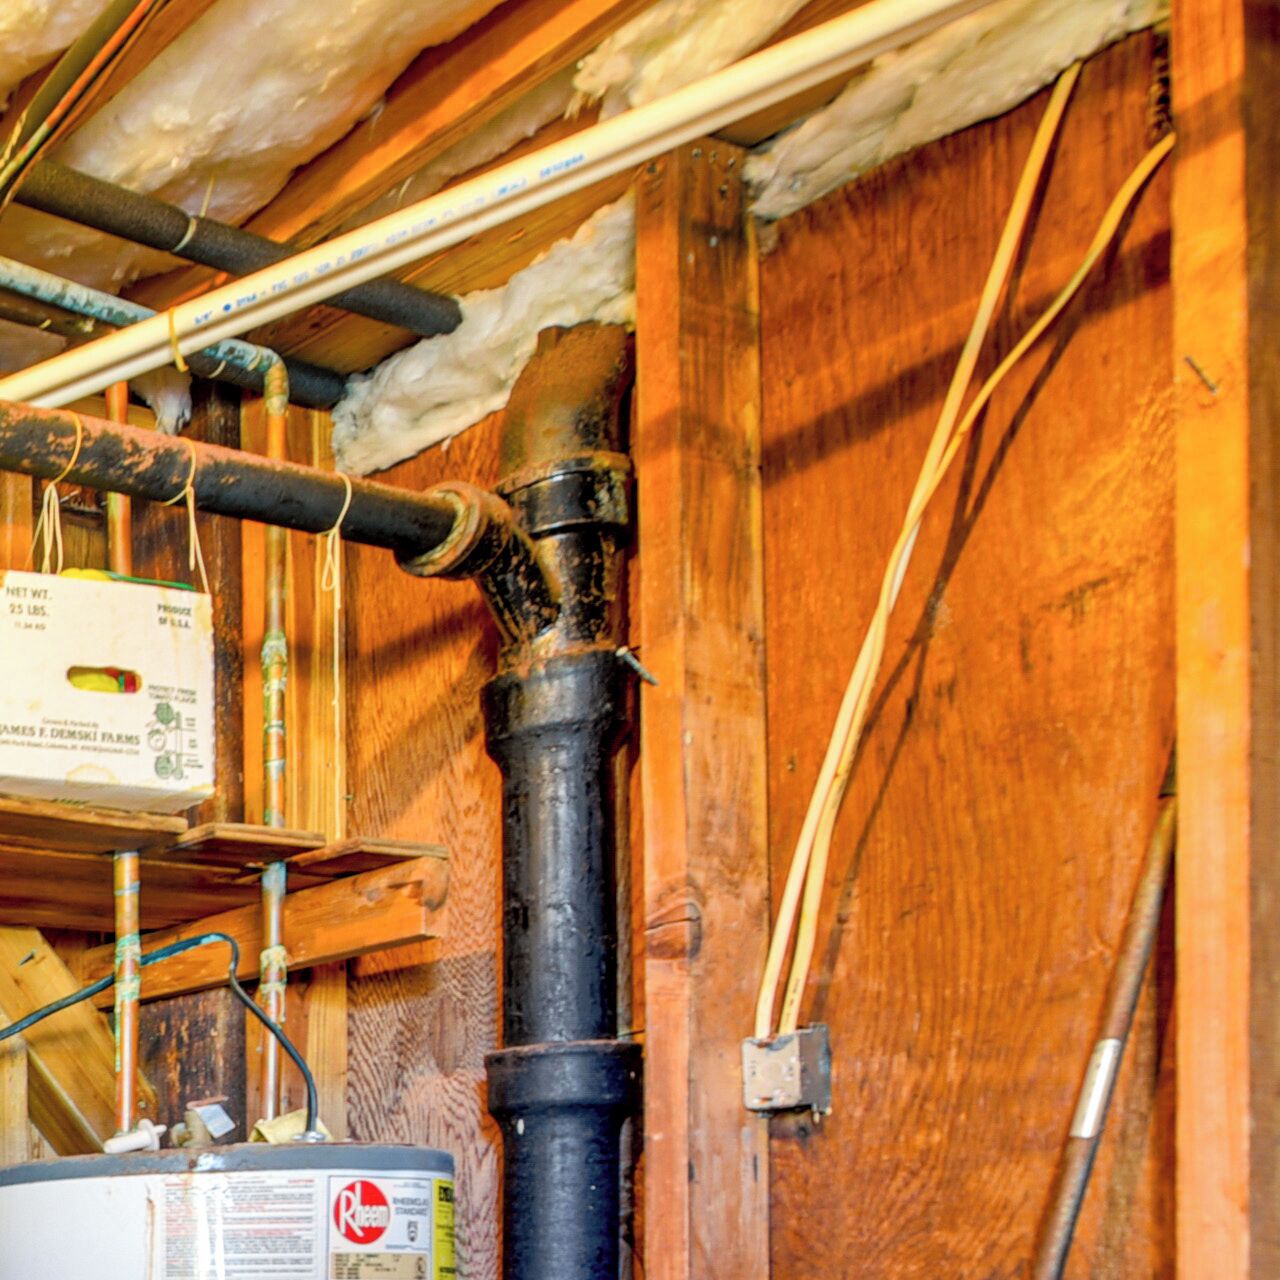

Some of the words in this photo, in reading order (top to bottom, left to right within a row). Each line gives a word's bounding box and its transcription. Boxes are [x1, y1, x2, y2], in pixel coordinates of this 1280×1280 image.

[6, 586, 28, 600] NET
[31, 588, 53, 601] WT.
[9, 603, 24, 615] 25
[27, 604, 50, 617] LBS.
[157, 604, 192, 617] PRODUCE
[50, 728, 97, 742] DEMSKI
[101, 732, 141, 746] FARMS
[339, 1180, 390, 1239] Rheem
